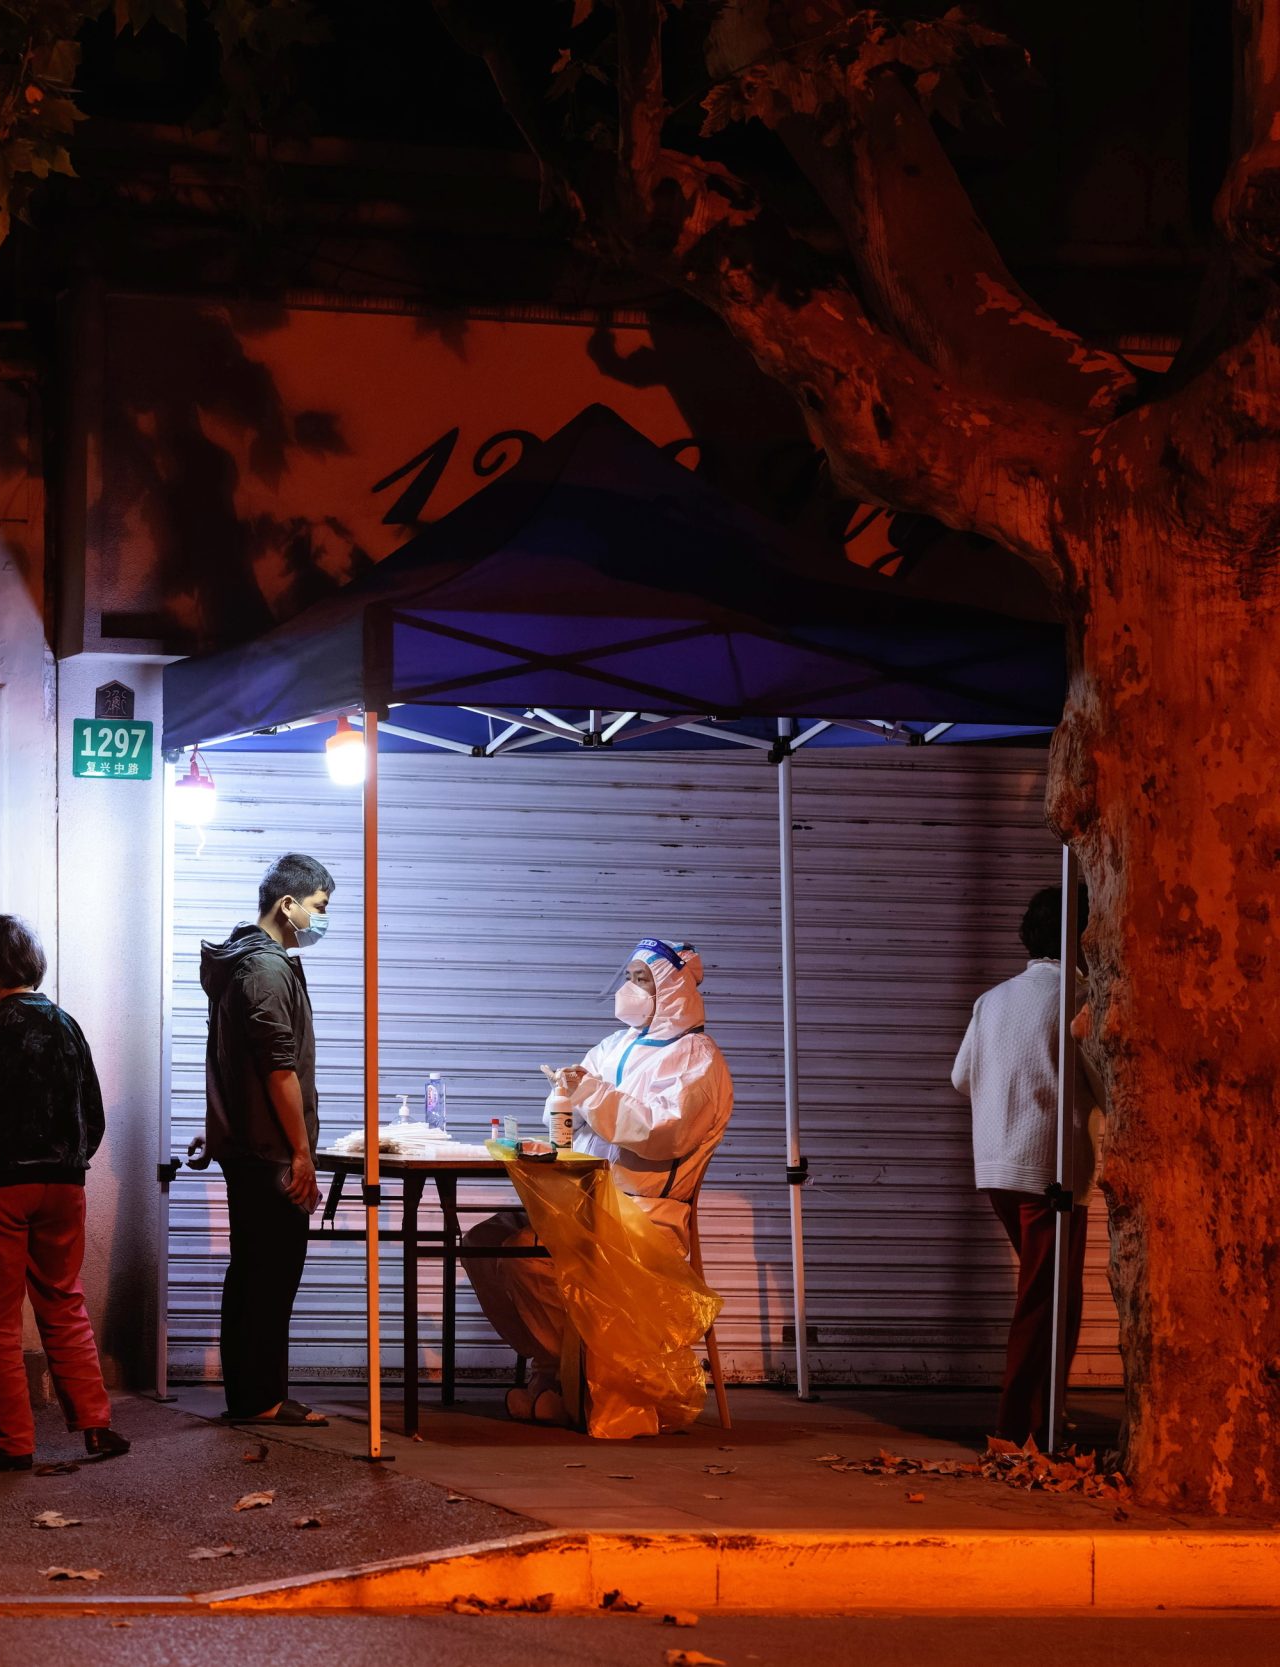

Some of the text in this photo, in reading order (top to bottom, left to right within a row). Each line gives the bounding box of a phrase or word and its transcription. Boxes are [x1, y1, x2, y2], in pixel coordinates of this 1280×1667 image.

[80, 727, 146, 758] 1297
[86, 761, 139, 774] 复兴中路
